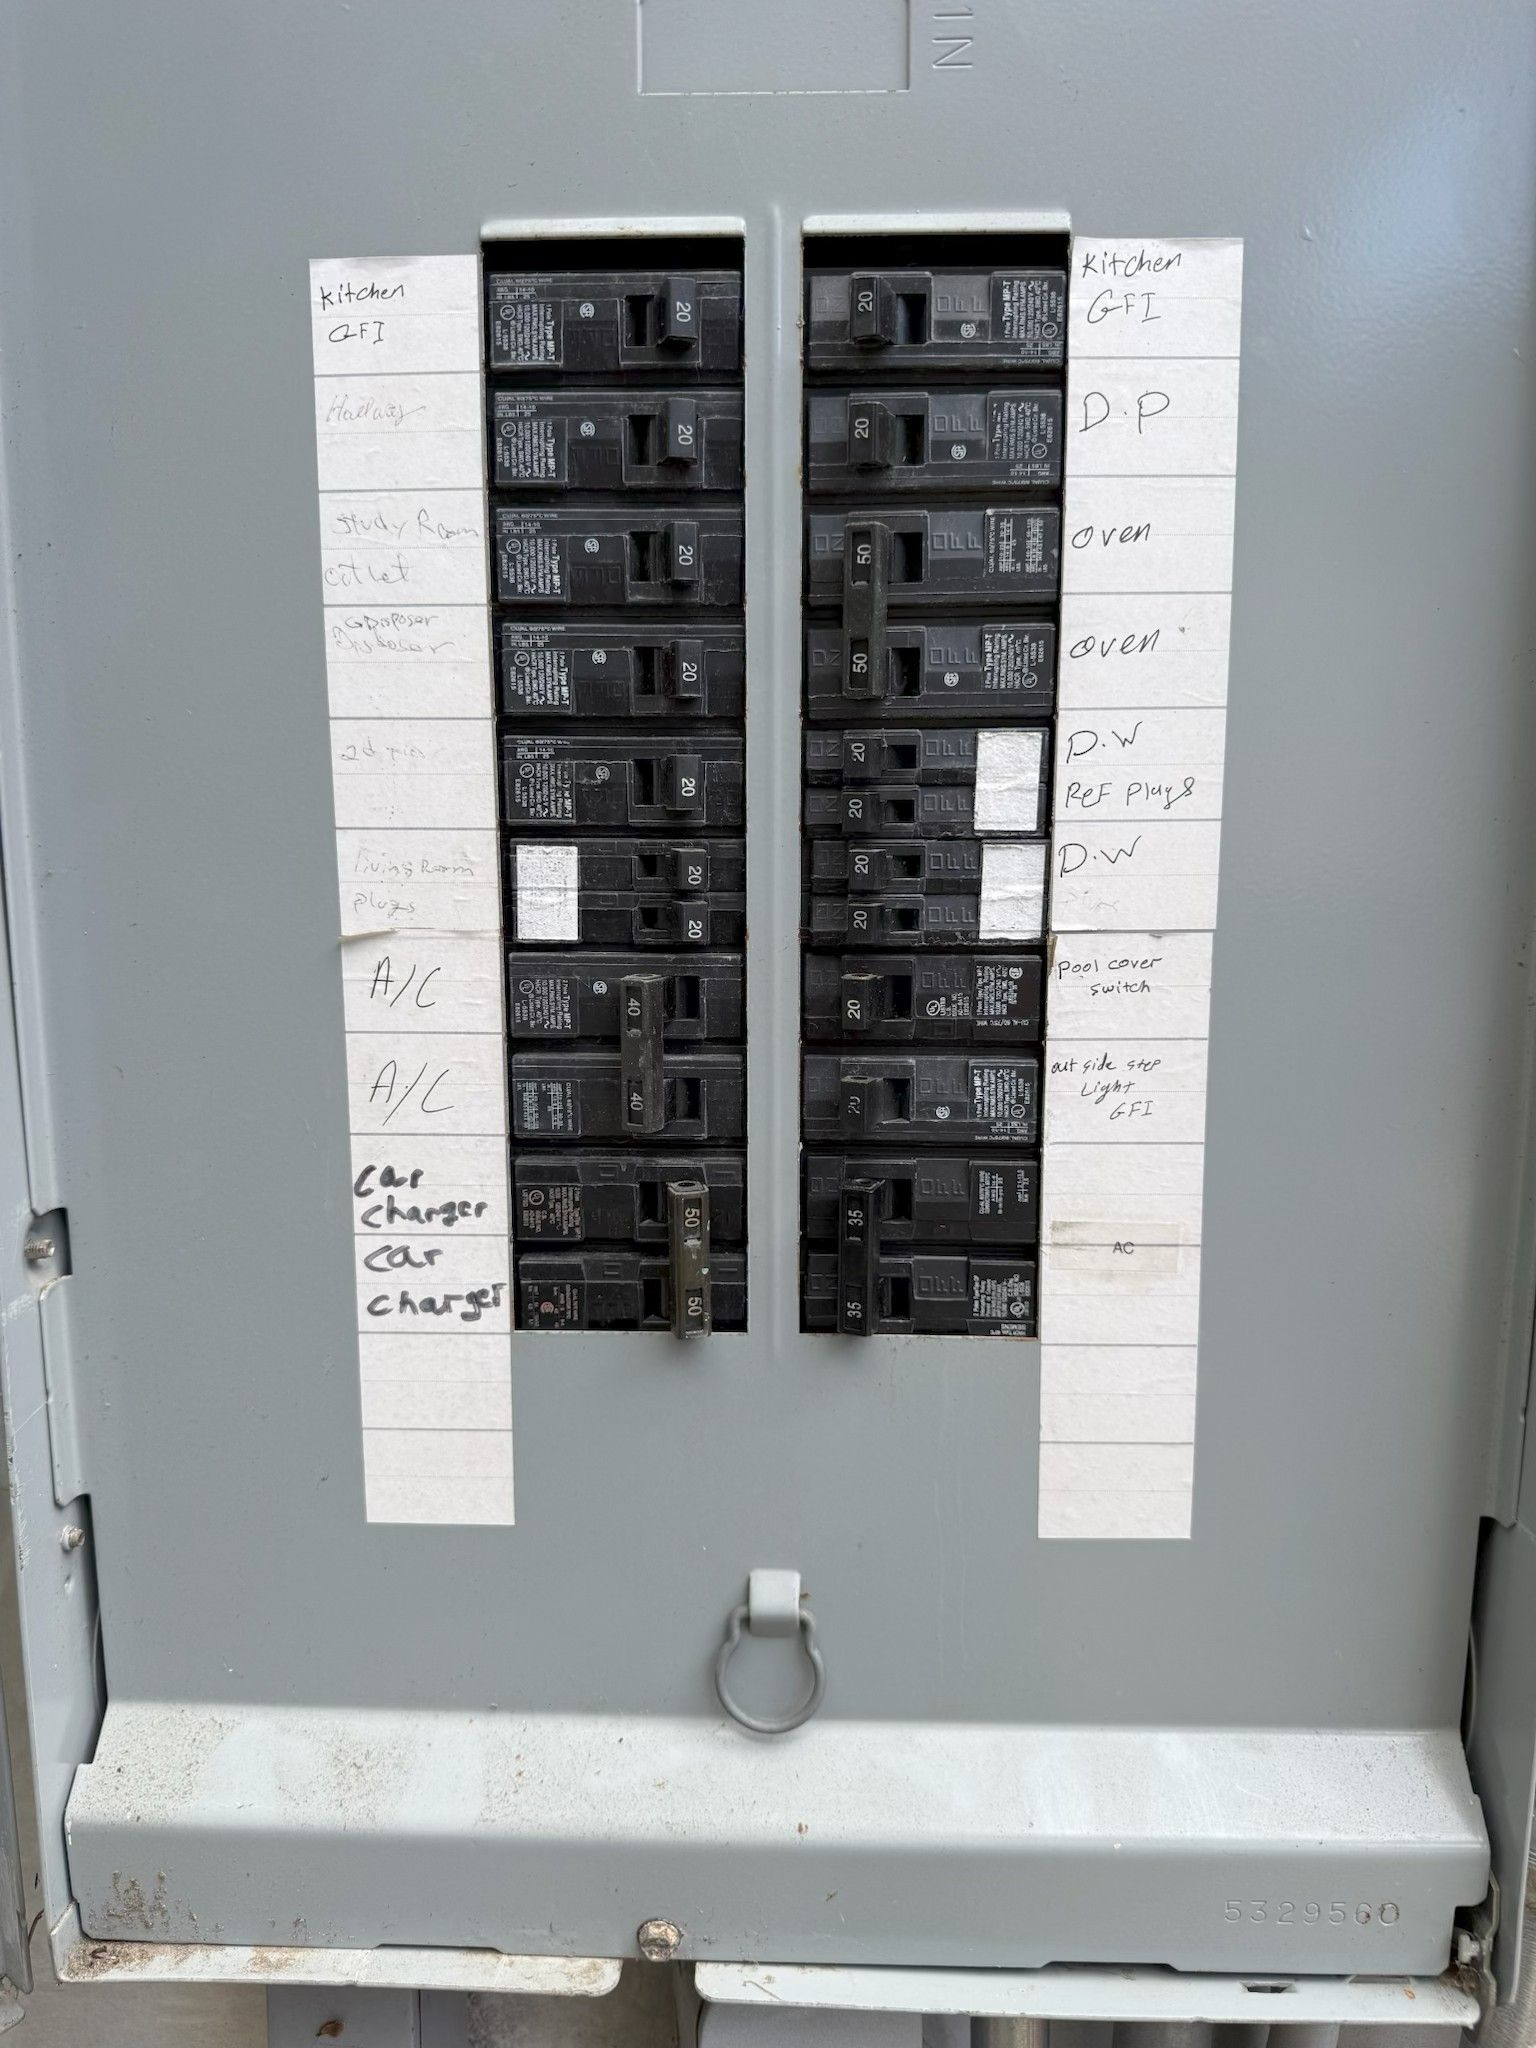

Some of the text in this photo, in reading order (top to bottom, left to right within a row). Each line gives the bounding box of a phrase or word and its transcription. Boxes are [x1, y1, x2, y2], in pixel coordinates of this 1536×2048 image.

[858, 292, 872, 312] 20
[936, 296, 985, 312] OFF
[1002, 302, 1012, 321] Type
[1087, 288, 1161, 323] GFI
[676, 301, 690, 323] 20
[546, 321, 554, 340] Type
[855, 419, 869, 438] 20
[935, 415, 984, 432] OFF
[678, 424, 693, 446] 20
[546, 439, 555, 456] Type
[932, 532, 981, 550] OFF
[679, 545, 694, 567] 20
[858, 544, 871, 564] 50
[551, 556, 560, 573] Type
[853, 653, 867, 673] 50
[930, 648, 979, 664] OFF
[559, 668, 568, 685] Type
[682, 662, 697, 682] 20
[851, 743, 865, 762] 20
[926, 740, 972, 755] OFF
[680, 777, 695, 797] 20
[849, 799, 862, 818] 20
[924, 794, 970, 811] OFF
[855, 855, 868, 874] 20
[930, 853, 976, 869] OFF
[688, 865, 702, 884] 20
[854, 911, 867, 929] 20
[929, 907, 975, 922] OFF
[688, 920, 702, 939] 20
[1108, 957, 1162, 970] cover
[370, 955, 441, 1008] A/C
[562, 996, 570, 1011] Type
[628, 998, 641, 1017] 40
[848, 1000, 860, 1019] 20
[369, 1059, 455, 1127] A/C
[630, 1092, 644, 1111] 40
[974, 1087, 983, 1103] Type
[1110, 1100, 1154, 1120] GFI
[685, 1208, 699, 1227] 50
[848, 1210, 863, 1226] 35
[1112, 1241, 1135, 1255] AC
[688, 1296, 702, 1316] 50
[848, 1302, 861, 1318] 35
[1224, 1900, 1400, 1926] 5329560
